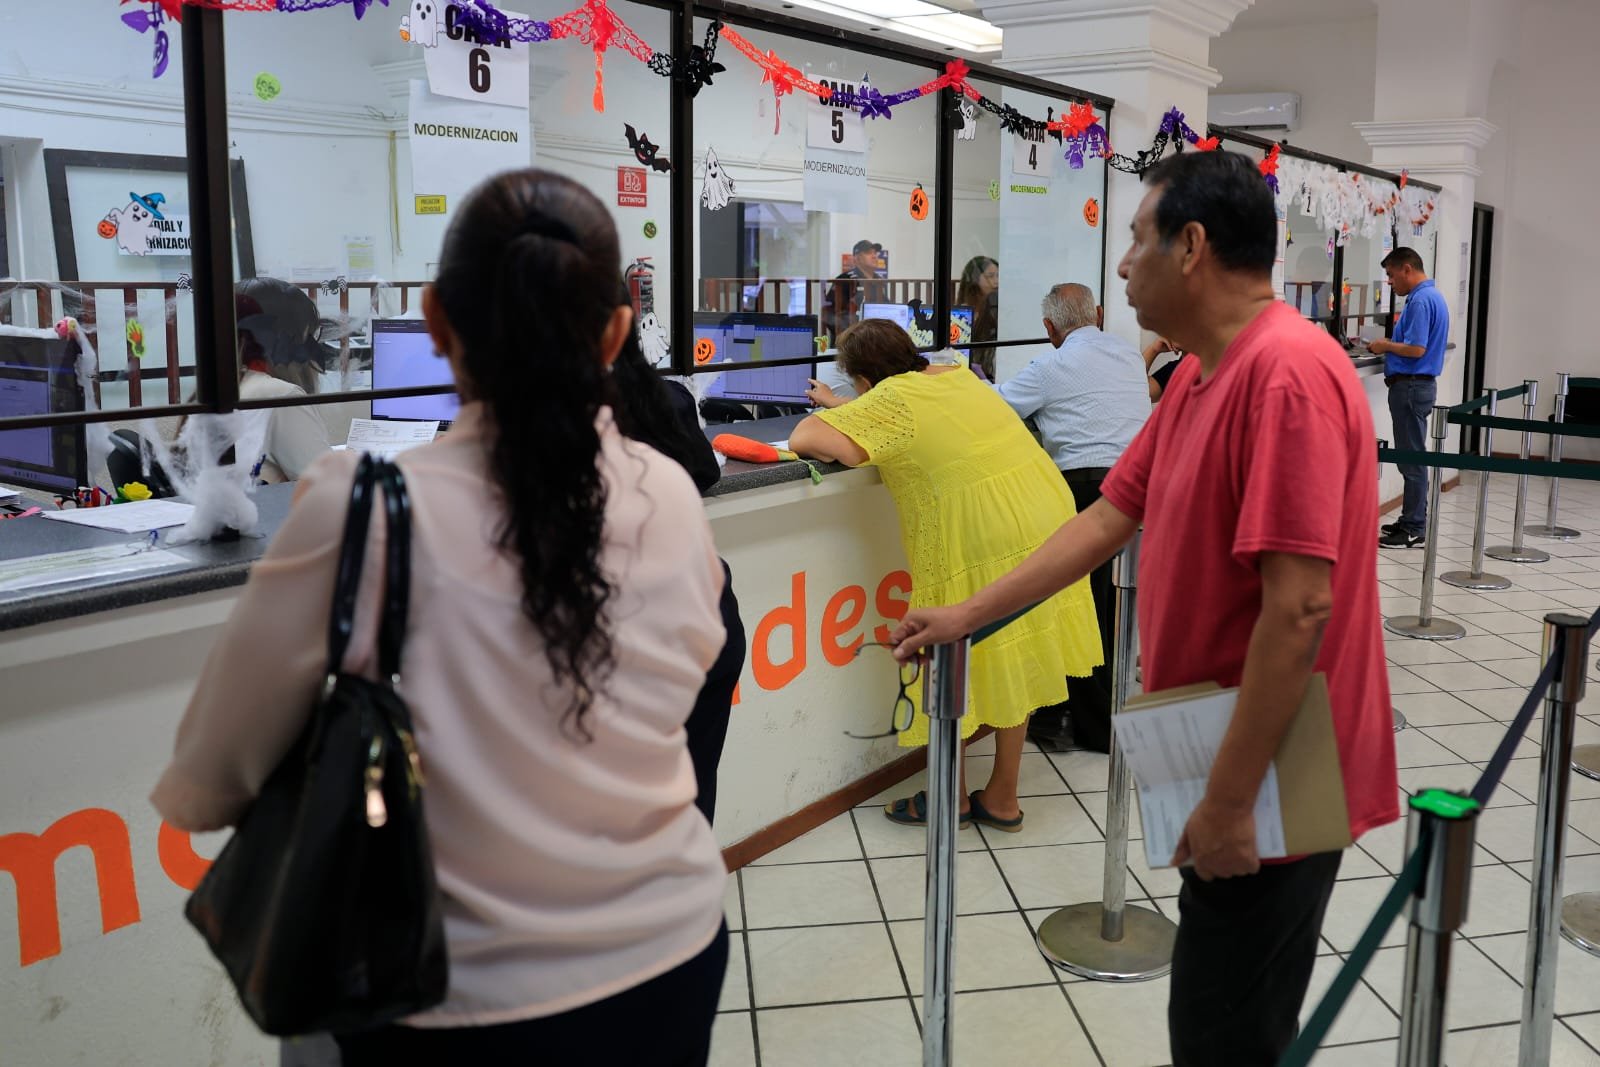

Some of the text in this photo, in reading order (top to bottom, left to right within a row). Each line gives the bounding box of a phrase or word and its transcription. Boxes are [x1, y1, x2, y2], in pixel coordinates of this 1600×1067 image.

[445, 4, 511, 48] CAA
[469, 48, 491, 93] 6
[414, 122, 518, 143] MODERNIZACION
[831, 110, 844, 143] 5
[803, 159, 866, 177] MODERNIZACION
[1029, 143, 1037, 170] 4
[153, 220, 183, 233] DIAL Y
[731, 569, 913, 706] des
